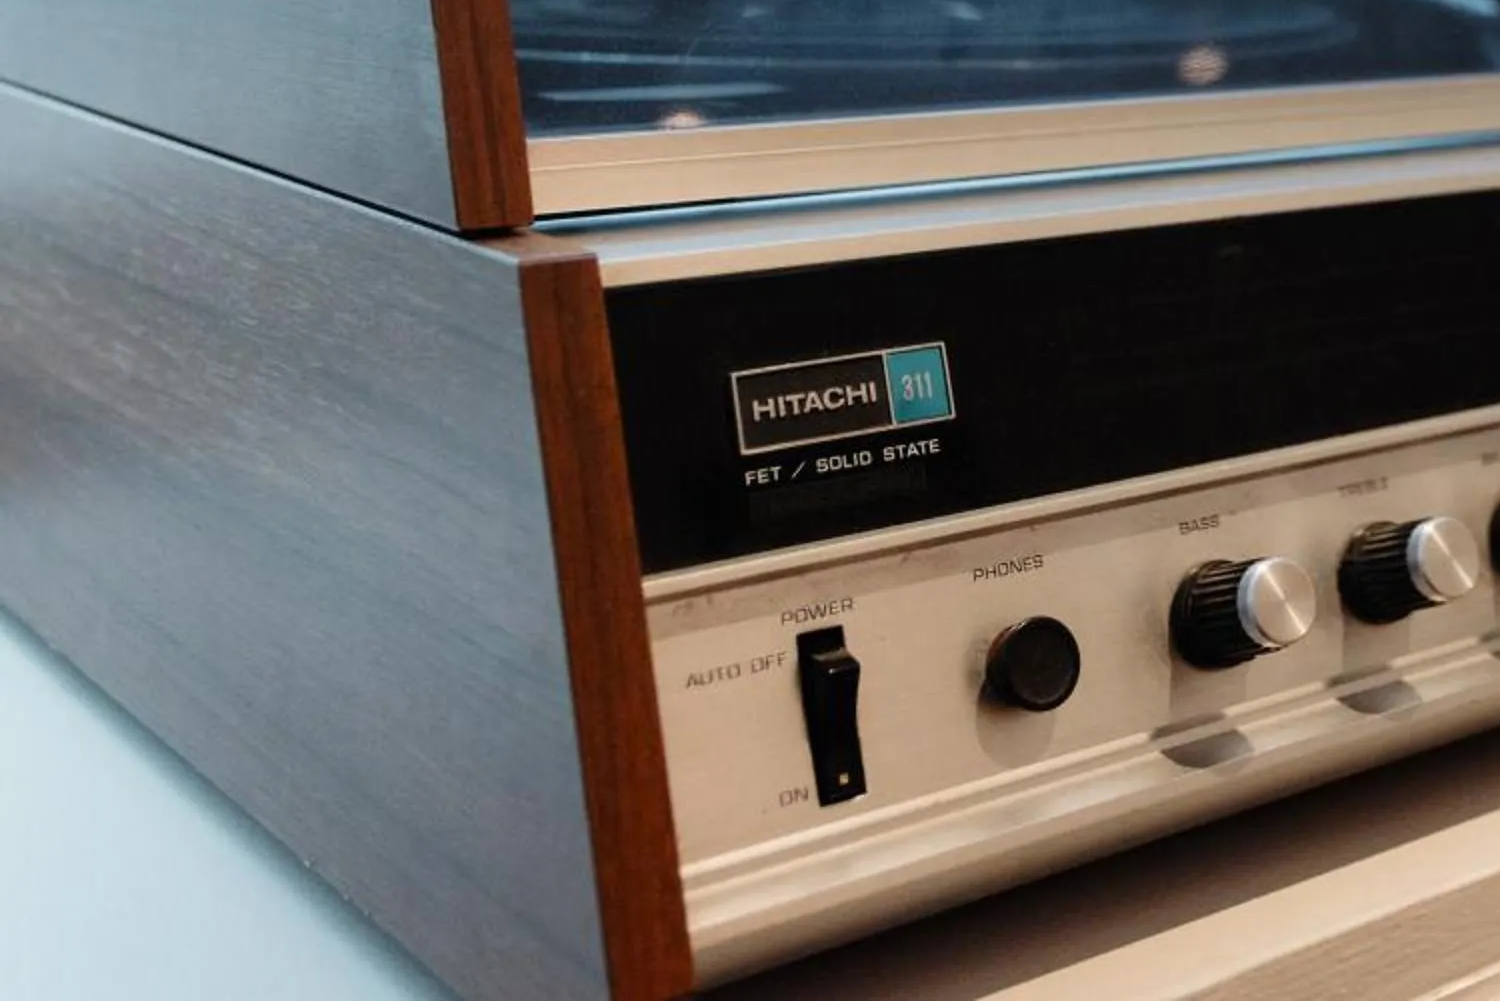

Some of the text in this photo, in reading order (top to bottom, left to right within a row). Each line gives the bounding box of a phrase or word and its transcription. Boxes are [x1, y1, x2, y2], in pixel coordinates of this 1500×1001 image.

[752, 371, 933, 422] HITACHI 311
[744, 466, 782, 486] FET
[816, 451, 873, 473] SOLID
[883, 439, 941, 462] STATE
[1179, 513, 1219, 535] BASS
[973, 554, 1043, 582] PHONES
[781, 599, 853, 625] POWER
[686, 651, 786, 688] AUTO OFF
[779, 787, 808, 807] ON
